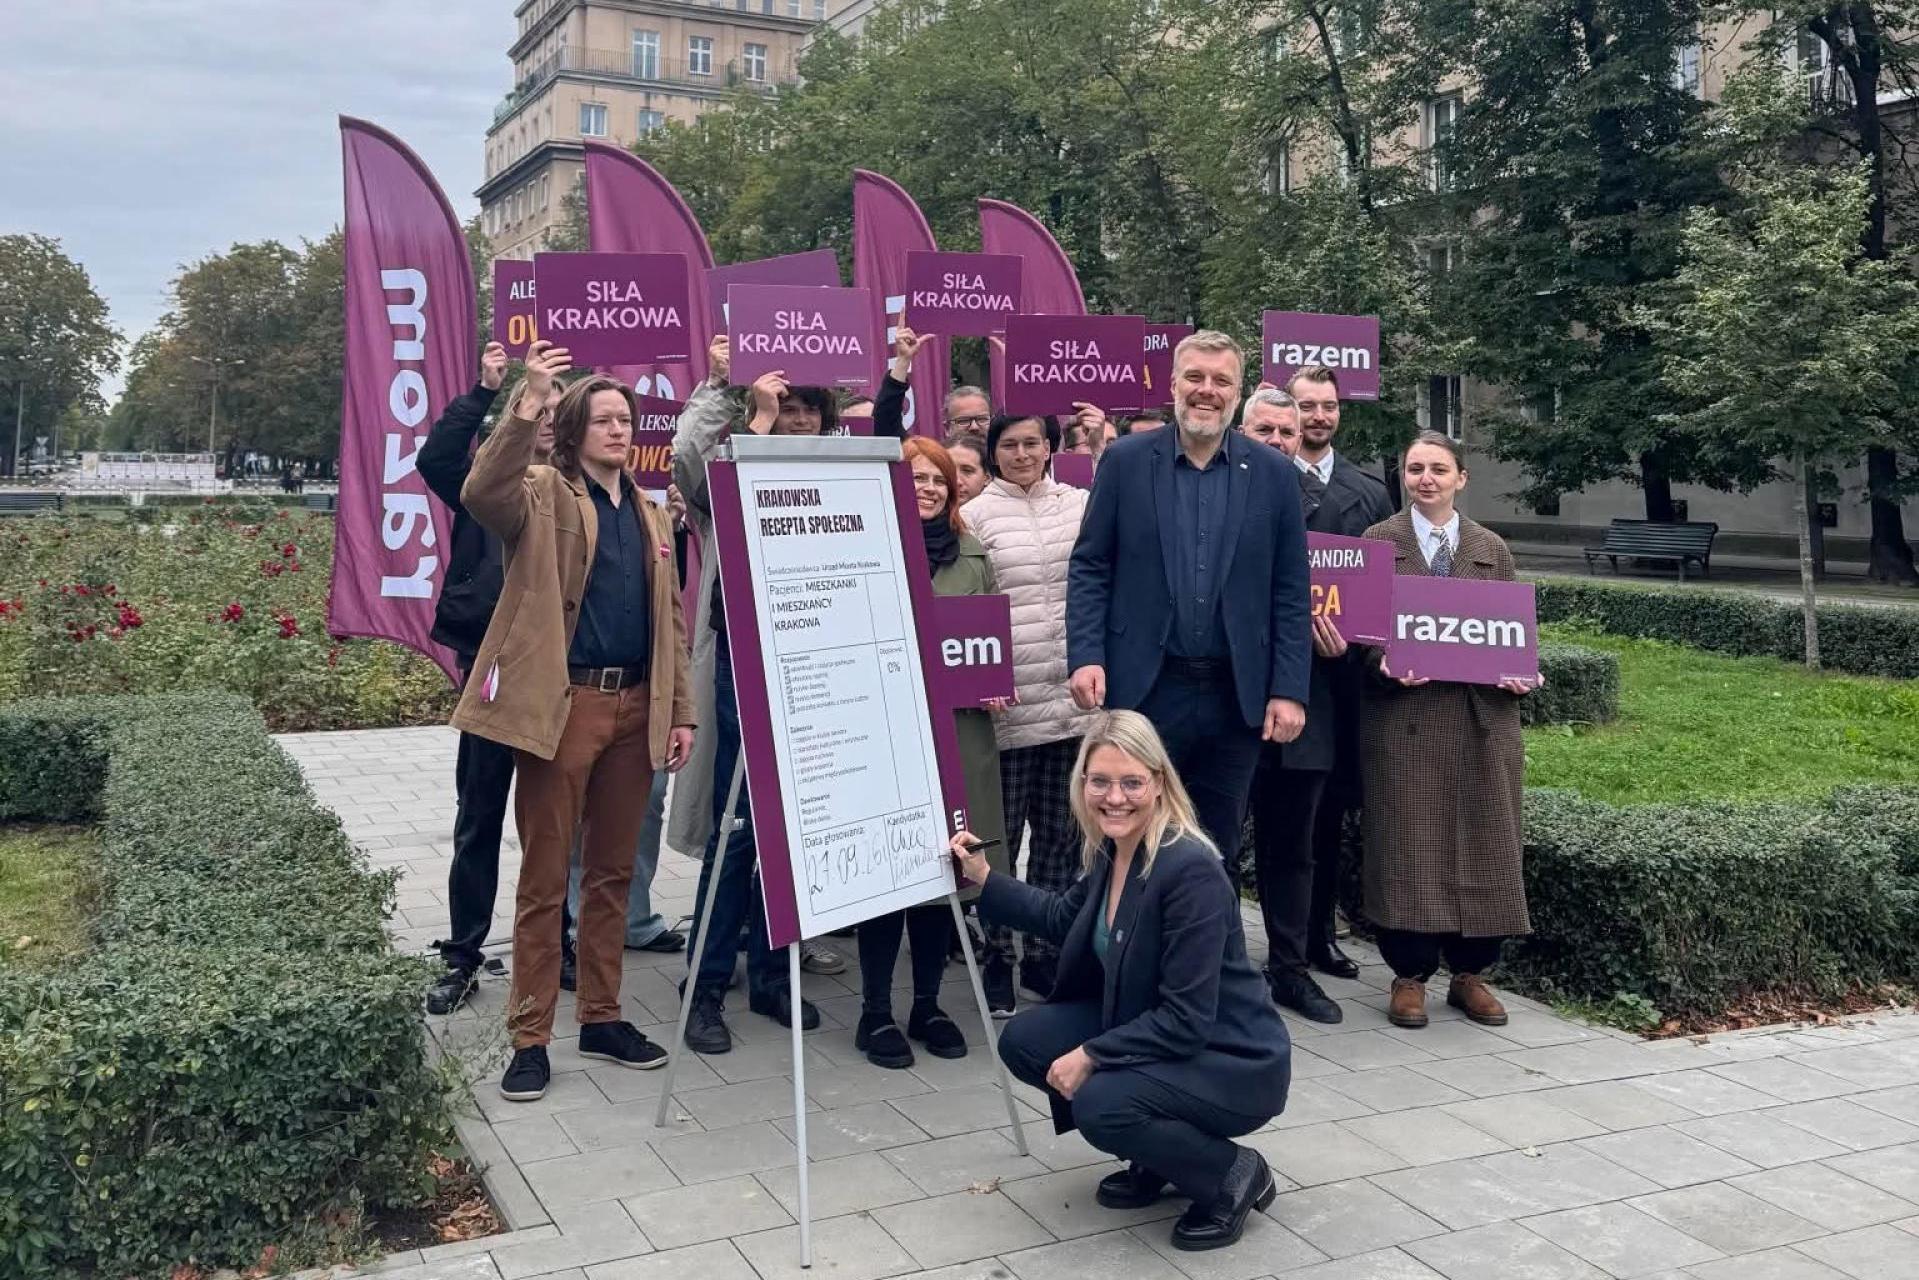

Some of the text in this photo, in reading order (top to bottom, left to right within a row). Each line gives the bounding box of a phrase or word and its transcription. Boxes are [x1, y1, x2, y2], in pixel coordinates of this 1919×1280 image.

[586, 280, 643, 302] SIŁA
[943, 273, 986, 291] SIŁA
[912, 290, 1015, 311] KRAKOWA
[547, 308, 681, 330] KRAKOWA
[774, 310, 827, 331] SIŁA
[739, 333, 863, 355] KRAKOWA
[1050, 340, 1100, 360] SIŁA
[1272, 341, 1370, 369] razem
[1014, 364, 1136, 383] KRAKOWA
[381, 268, 438, 599] razem
[756, 488, 822, 509] KRAKOWSKA
[760, 514, 865, 537] RECEPTA SPOŁECZNA
[805, 578, 857, 592] MIESZKANKI
[774, 617, 821, 632] KRAKOWA
[1397, 613, 1526, 648] razem
